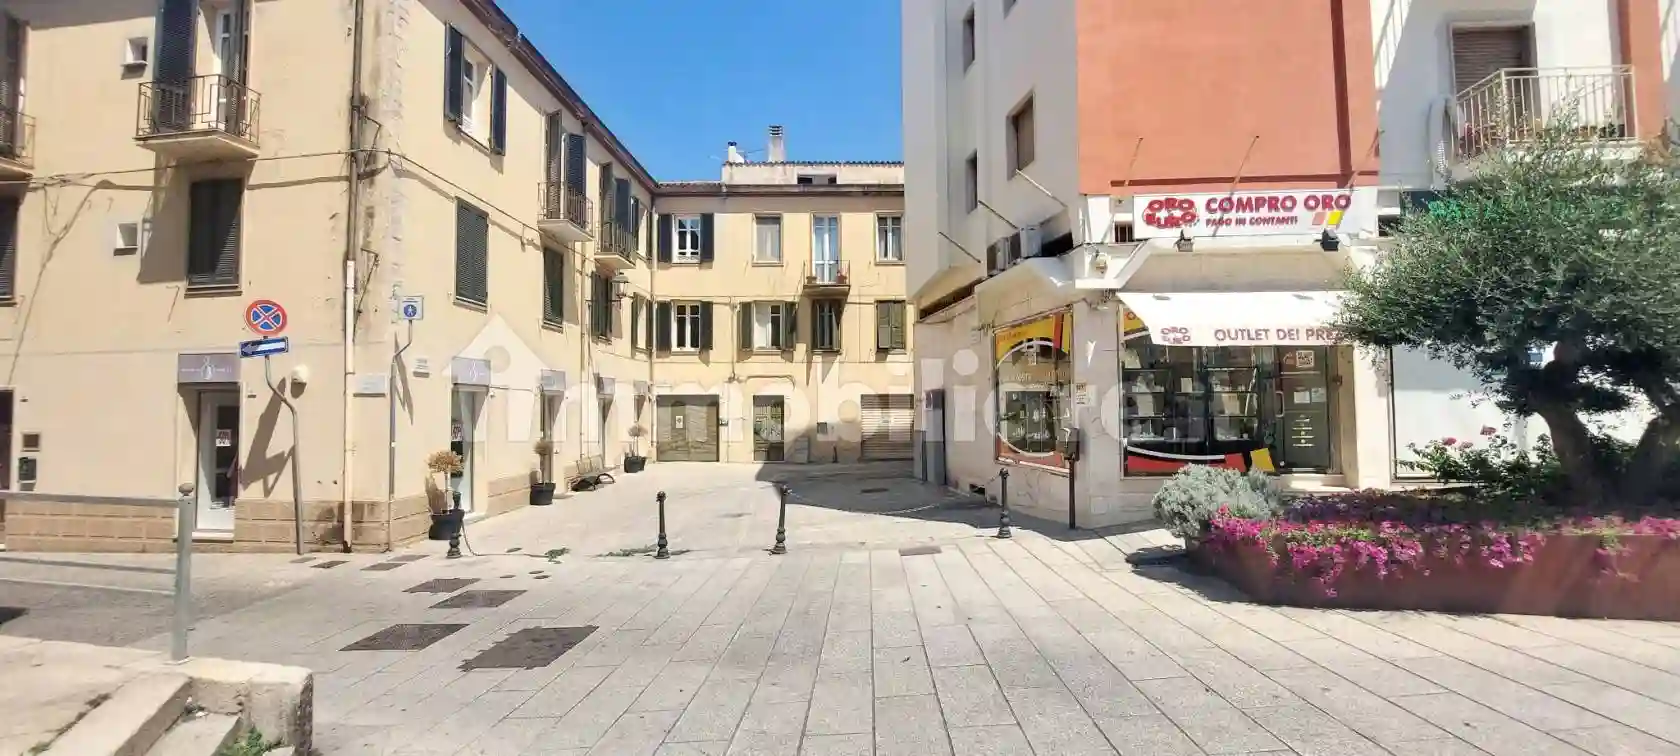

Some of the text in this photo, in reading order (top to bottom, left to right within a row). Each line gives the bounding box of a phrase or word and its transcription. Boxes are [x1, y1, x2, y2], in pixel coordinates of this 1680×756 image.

[1147, 198, 1195, 212] ORO
[1205, 193, 1351, 214] COMPRO ORO
[1145, 211, 1197, 229] EURO
[1205, 215, 1298, 227] PAGO IN CONTANTI
[1160, 326, 1189, 335] ORO
[1213, 328, 1270, 342] OUTLET
[1275, 328, 1300, 341] DEI
